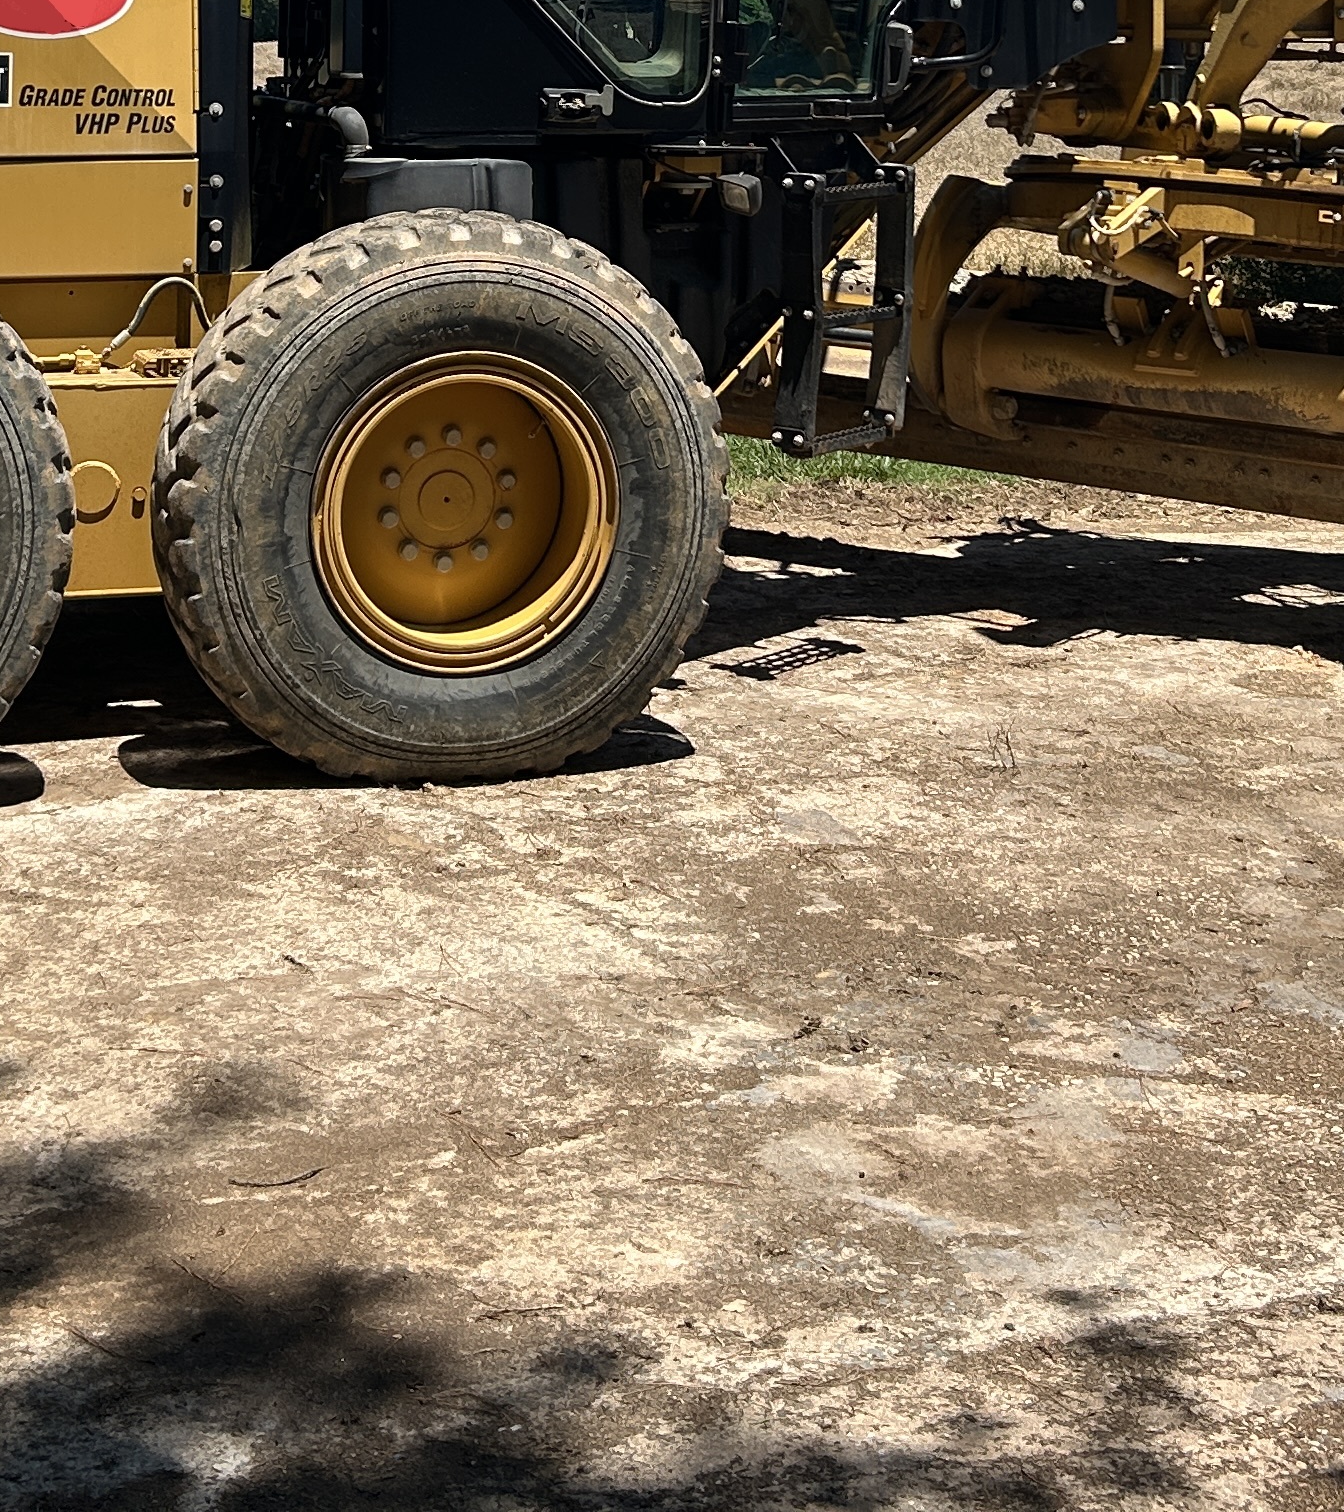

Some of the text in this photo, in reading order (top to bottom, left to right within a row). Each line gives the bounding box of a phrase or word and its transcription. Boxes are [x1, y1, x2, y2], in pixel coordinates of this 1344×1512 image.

[18, 84, 176, 107] GRADE CONTROL
[75, 113, 176, 135] VHP PLUS
[262, 574, 409, 724] MAXAM
